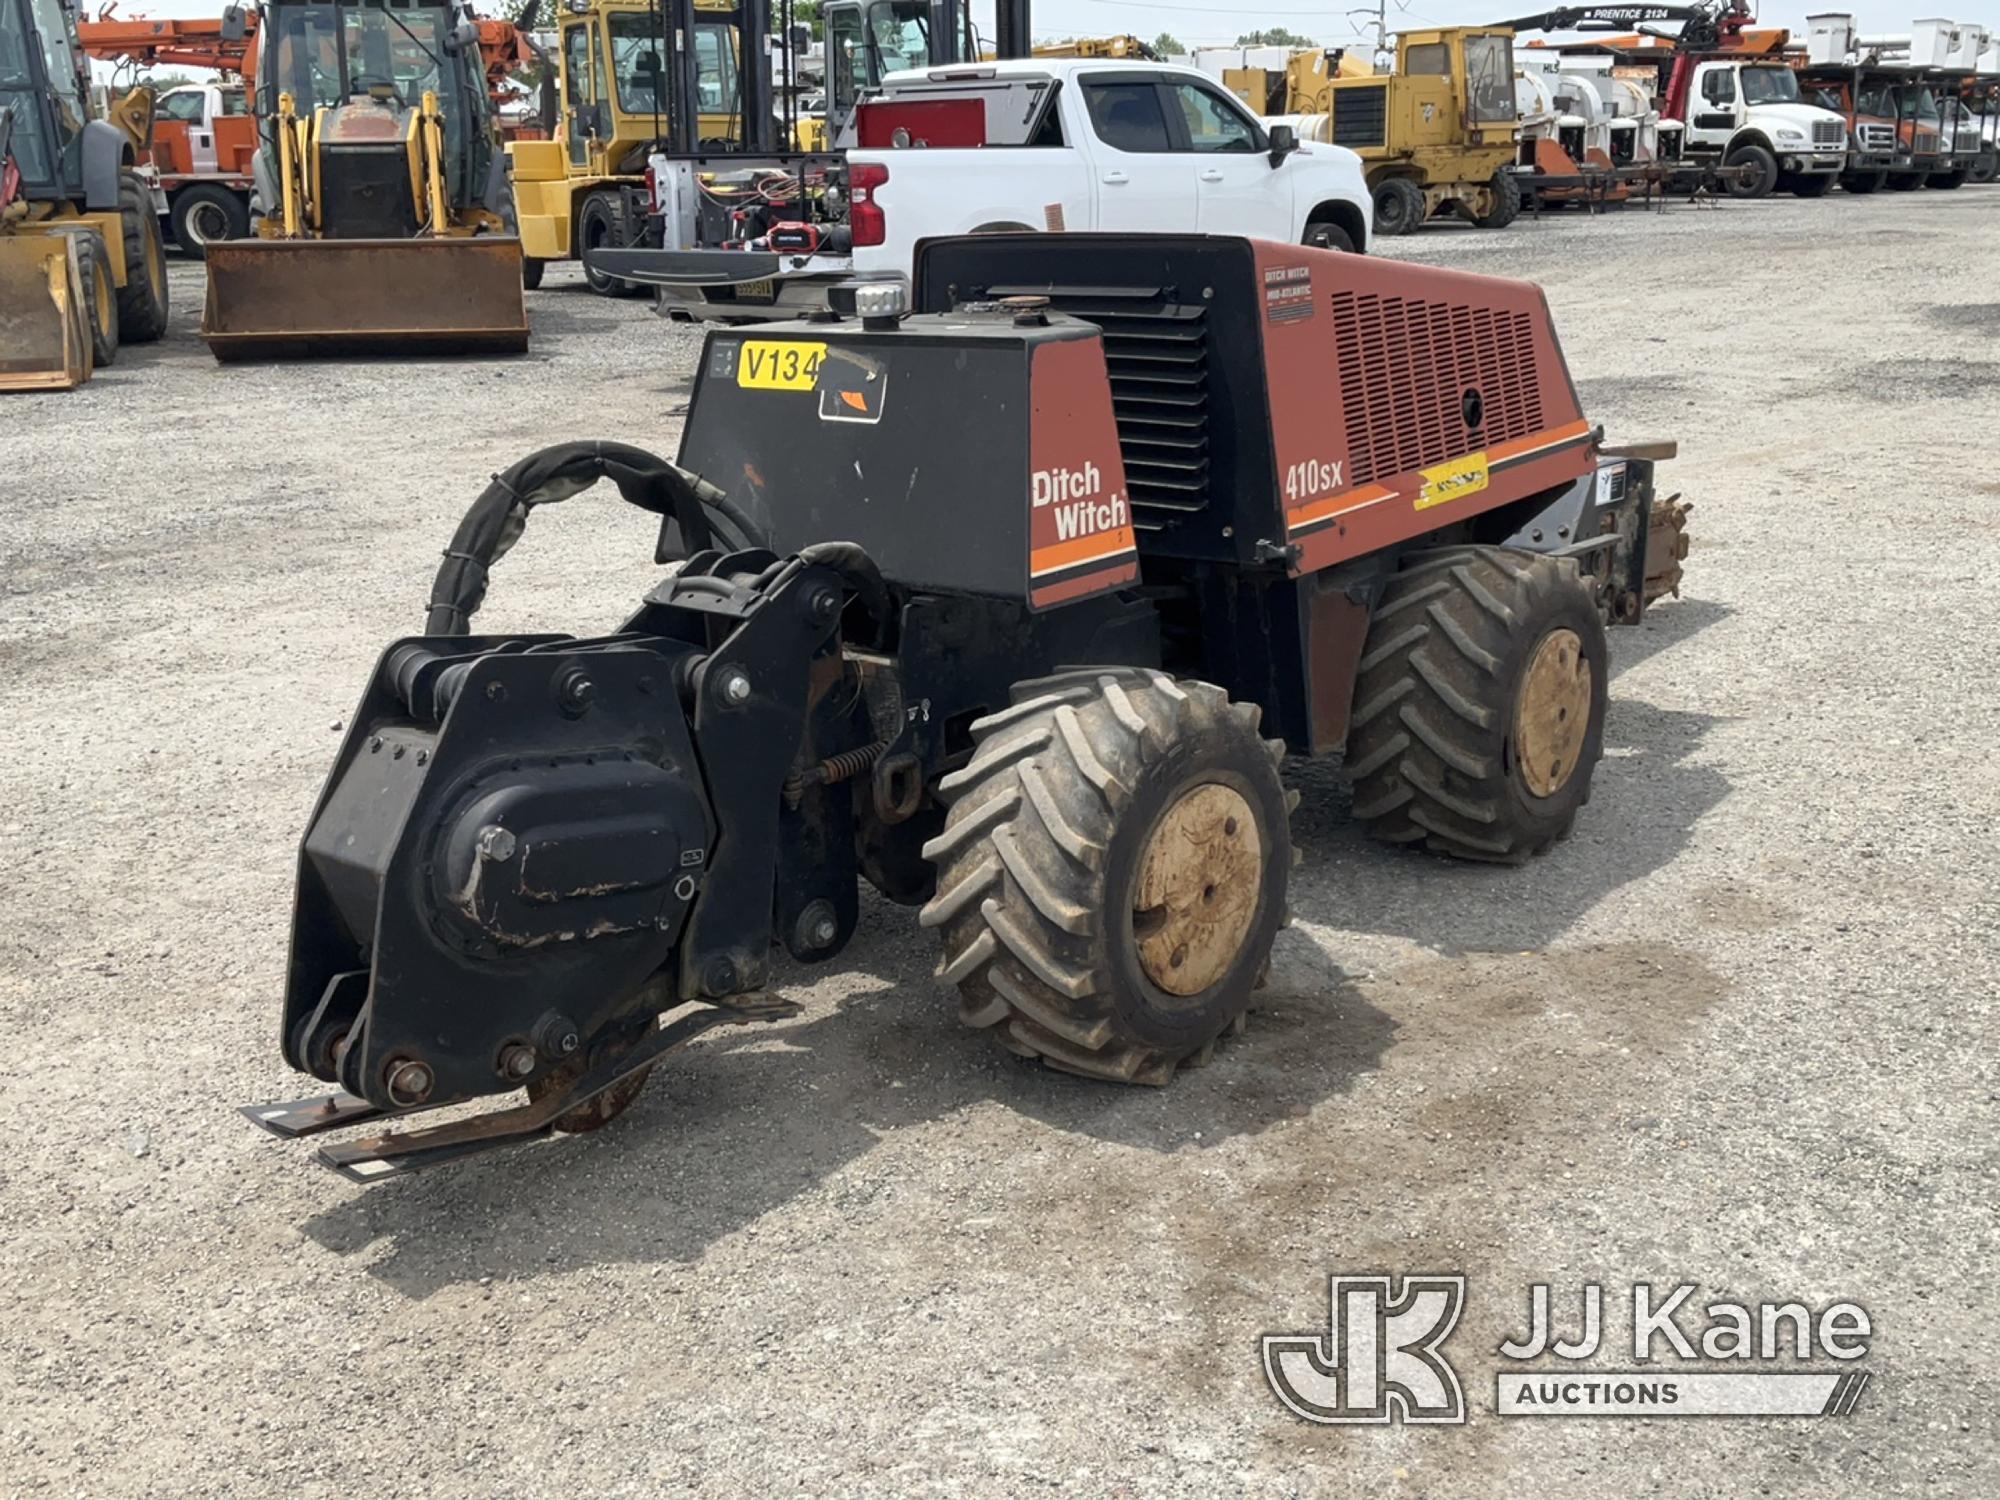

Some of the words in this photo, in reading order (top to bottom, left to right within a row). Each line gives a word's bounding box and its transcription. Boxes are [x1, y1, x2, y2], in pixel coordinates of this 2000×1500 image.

[1593, 9, 1641, 19] PRENTICE
[1644, 9, 1668, 19] 2124
[747, 348, 819, 382] V134
[1032, 461, 1100, 508] Ditch
[1053, 493, 1126, 541] Witch
